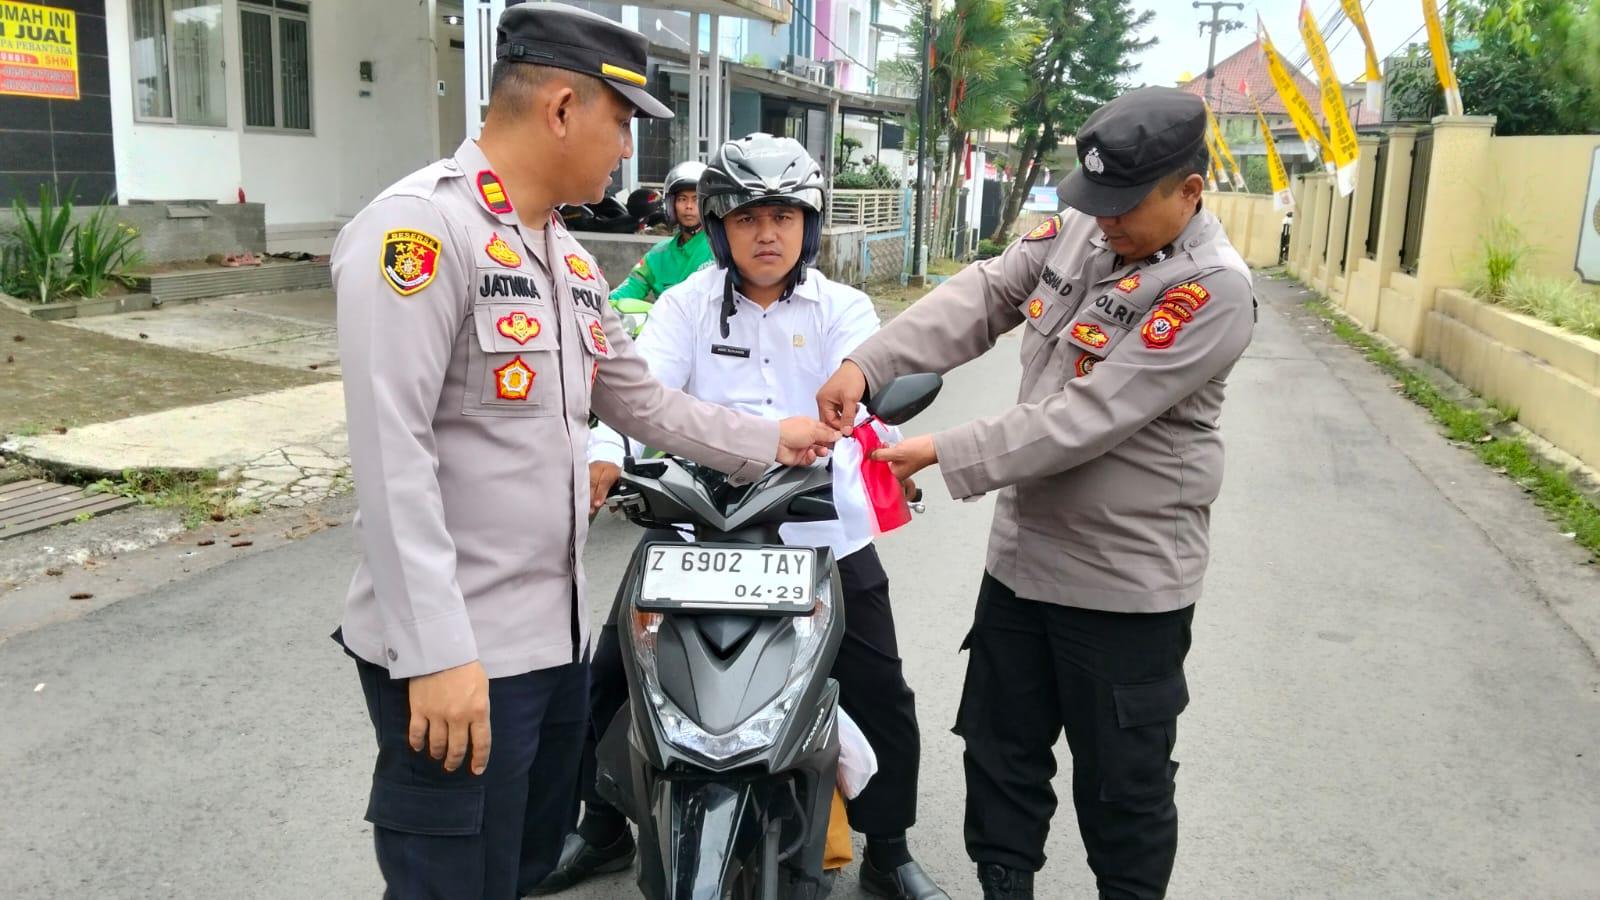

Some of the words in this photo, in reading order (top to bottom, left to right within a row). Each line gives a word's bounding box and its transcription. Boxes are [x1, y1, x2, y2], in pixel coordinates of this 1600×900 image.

[0, 5, 42, 24] MAH
[50, 11, 71, 29] INI
[15, 25, 71, 45] JUAL
[480, 274, 541, 300] JATNIKA
[1060, 283, 1073, 297] D
[651, 551, 665, 571] Z
[681, 552, 742, 573] 6902
[761, 553, 805, 575] TAY
